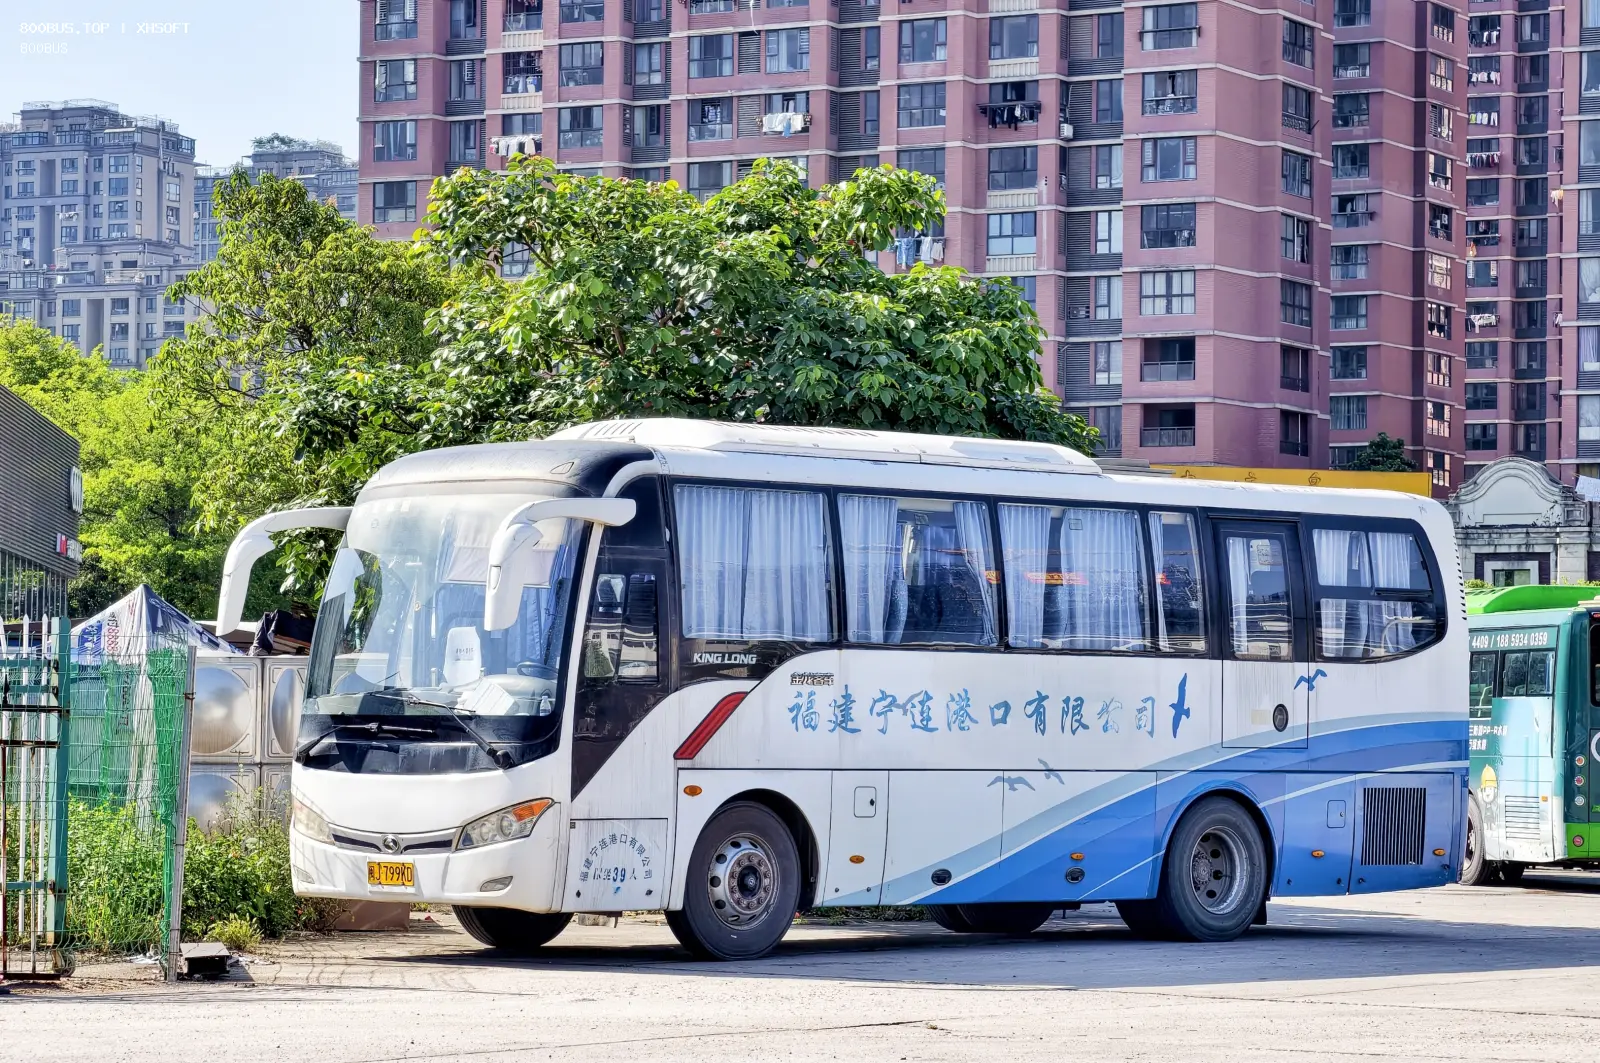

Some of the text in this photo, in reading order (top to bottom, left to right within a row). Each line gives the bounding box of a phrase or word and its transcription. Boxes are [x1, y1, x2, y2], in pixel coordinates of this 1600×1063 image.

[1471, 635, 1489, 649] 4409
[1496, 633, 1510, 648] 188
[1510, 632, 1528, 647] 5934
[1530, 631, 1548, 646] 0359
[693, 652, 757, 665] KING LONG
